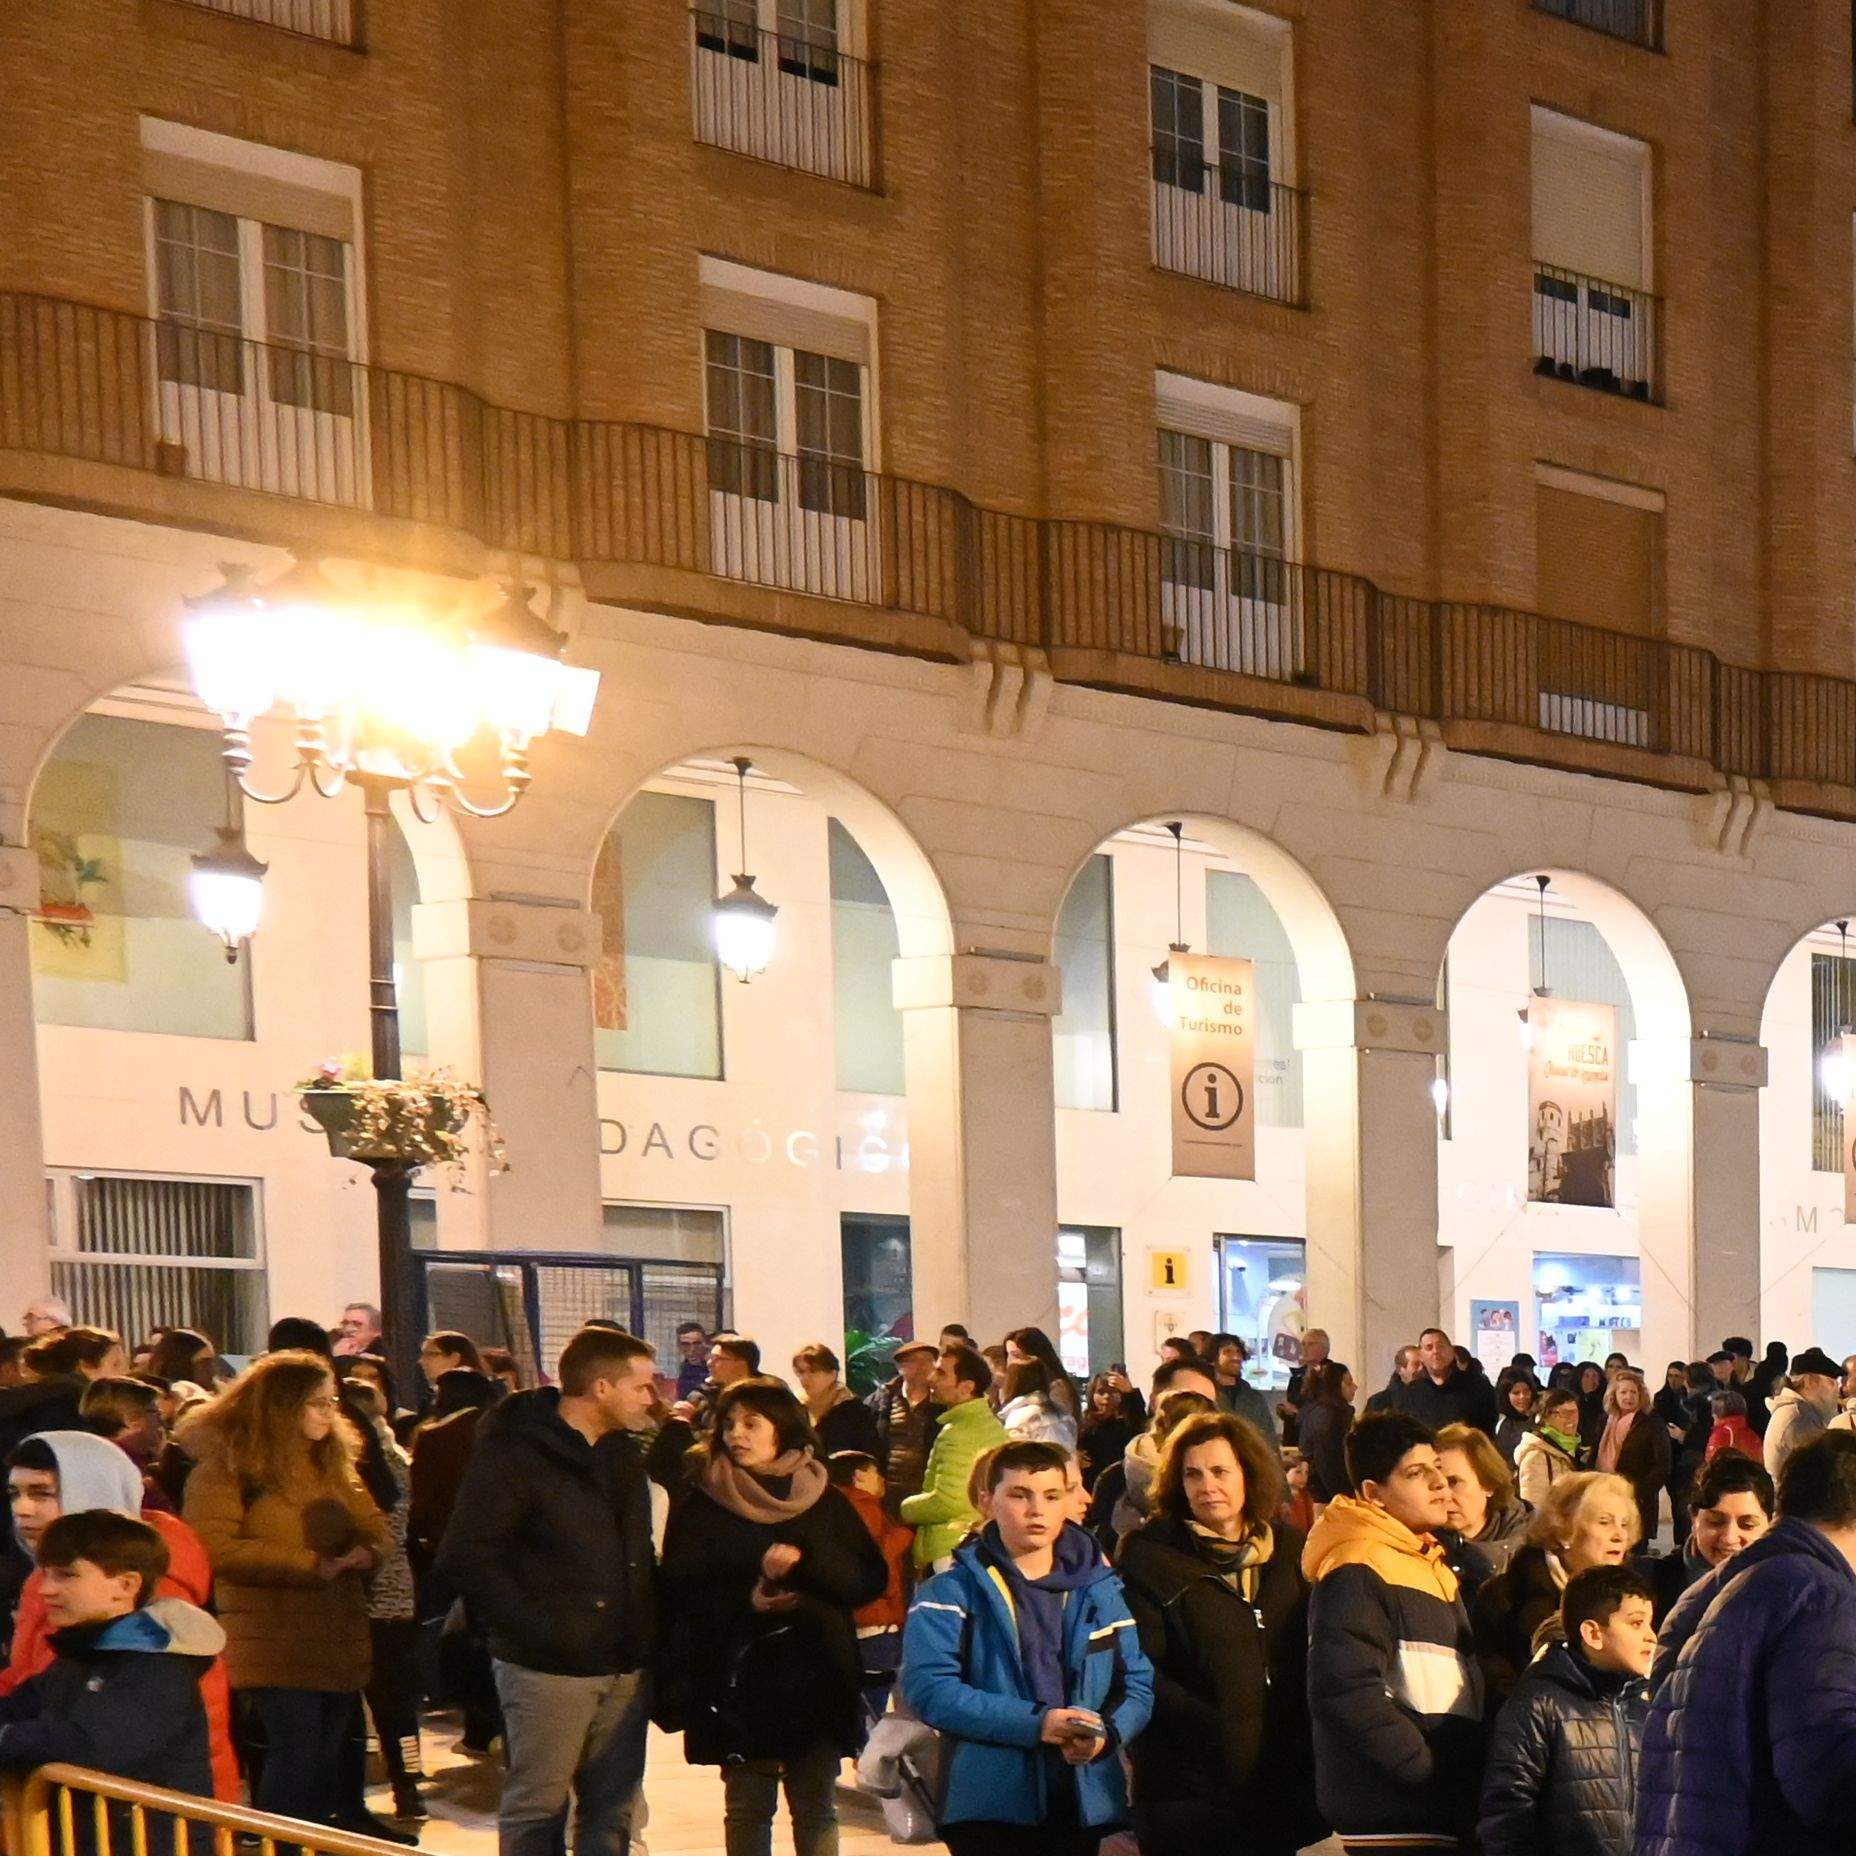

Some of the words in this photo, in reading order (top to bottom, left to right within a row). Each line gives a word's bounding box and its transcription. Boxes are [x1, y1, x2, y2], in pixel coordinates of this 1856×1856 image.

[1186, 976, 1242, 996] Oficina
[1223, 1001, 1242, 1016] de
[1179, 1016, 1243, 1036] Turismo
[1568, 1043, 1609, 1067] HUESCA
